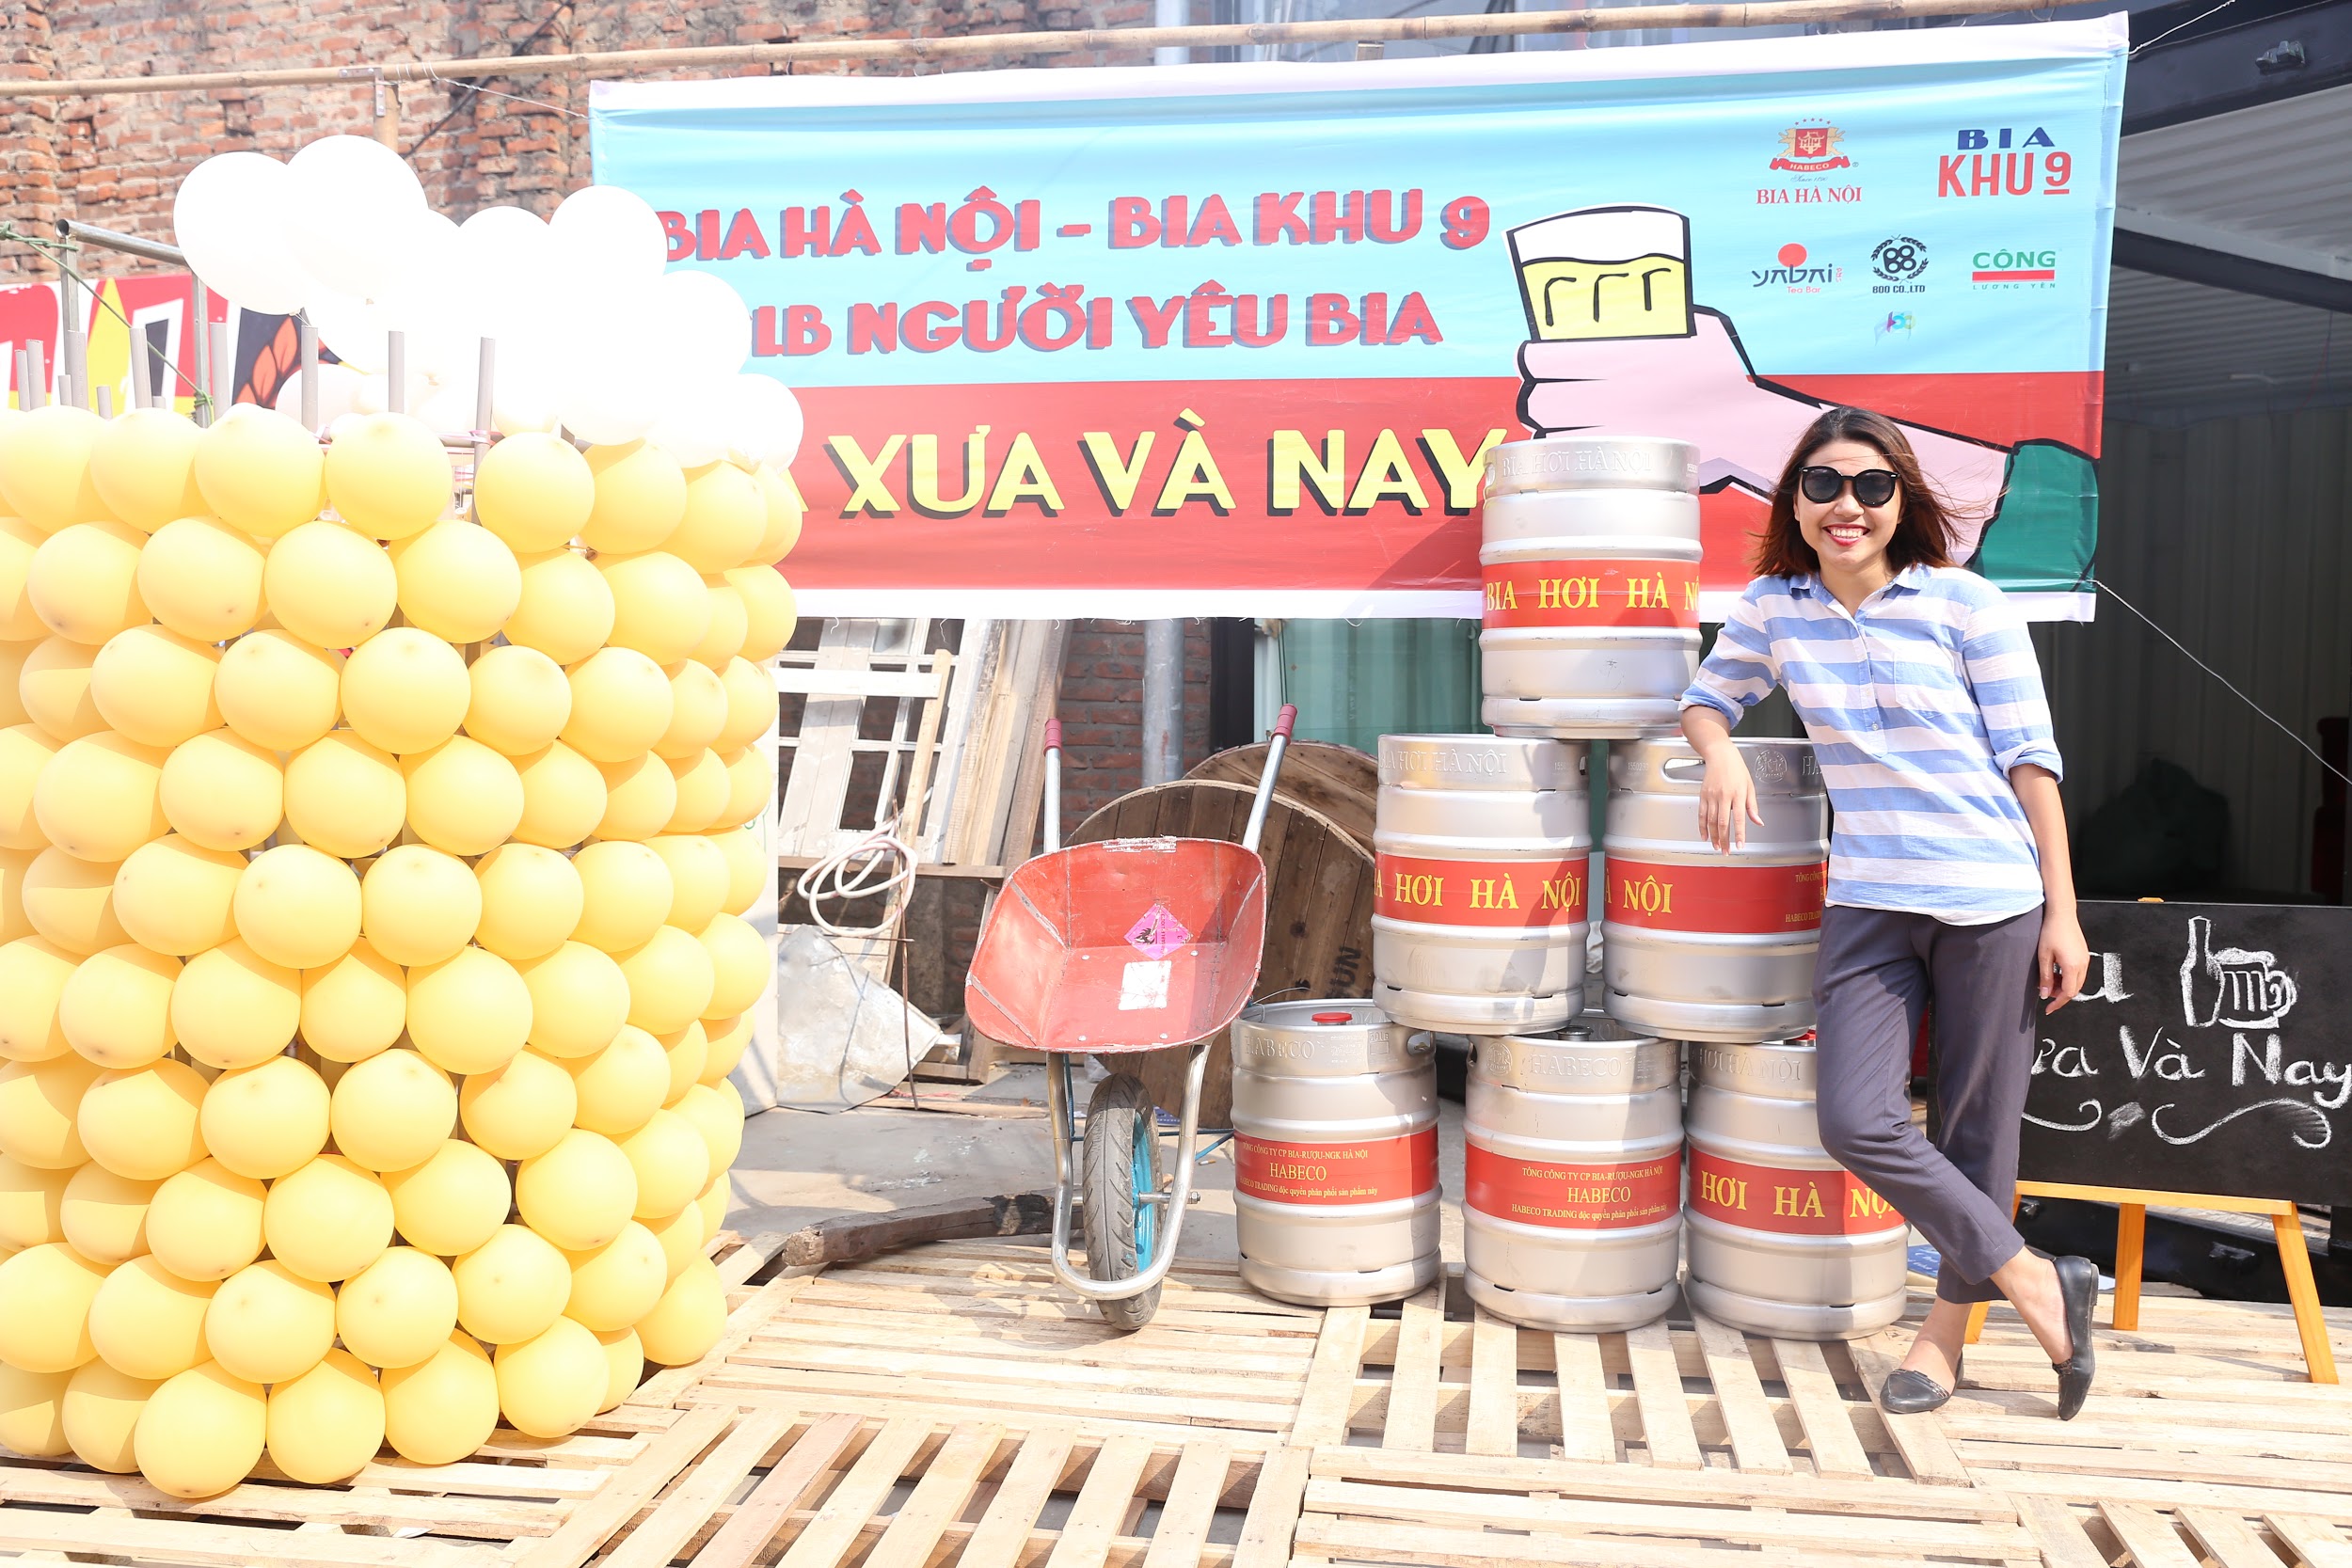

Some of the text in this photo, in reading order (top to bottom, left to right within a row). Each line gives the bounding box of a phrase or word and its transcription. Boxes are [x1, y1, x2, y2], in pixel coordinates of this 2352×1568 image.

[1958, 127, 2055, 150] BIA
[1789, 163, 1830, 171] HABECO
[1790, 174, 1812, 182] Since
[1938, 151, 2072, 198] KHU 9
[1756, 184, 1862, 204] BIA HÀ NỘI
[656, 208, 771, 261] BIA
[780, 188, 882, 259] HÀ
[895, 185, 1041, 271] NỘI
[1108, 194, 1242, 248] BIA
[1253, 188, 1423, 247] KHU
[1439, 196, 1490, 250] 9
[1972, 248, 2057, 271] CỘNG
[1805, 285, 1821, 293] Bar
[1973, 281, 2057, 291] LƯƠNG YÊN
[750, 279, 1444, 356] LB NGƯỜI YÊU BIA
[822, 423, 1065, 520] XƯA
[1077, 407, 1236, 517] VÀ
[1267, 428, 1508, 517] NAY
[1531, 451, 1570, 474] HƠI
[1574, 446, 1609, 472] HÀ
[1486, 579, 1518, 611] BIA
[1537, 576, 1600, 610] HƠI
[1626, 571, 1670, 610] HÀ
[1431, 748, 1463, 772] HÀ
[1466, 749, 1507, 776] NỘI
[1374, 867, 1581, 912] IA HƠI HÀ NỘI
[1623, 874, 1674, 917] NỘI
[1244, 1035, 1316, 1060] HABECO
[1531, 1053, 1622, 1077] HABECO
[2119, 1025, 2206, 1081] Và
[2232, 1032, 2352, 1110] Nay
[1253, 1143, 1268, 1155] CÔNG
[1268, 1148, 1279, 1157] TY
[1278, 1148, 1287, 1158] CP
[1288, 1148, 1342, 1162] BIA-RƯỢU-NGK
[1343, 1148, 1354, 1160] HÀ
[1355, 1148, 1369, 1160] NỘI
[1269, 1162, 1327, 1181] HABECO
[1522, 1164, 1663, 1183] TỔNG CÔNG TY CP BIA-RƯỢU-NGK HÀ NỘI
[1254, 1180, 1279, 1193] TRADING
[1279, 1185, 1289, 1195] độc
[1289, 1185, 1307, 1197] quyền
[1323, 1186, 1337, 1198] phối
[1349, 1184, 1367, 1197] phẩm
[1566, 1185, 1631, 1204] HABECO
[1700, 1169, 1748, 1211] HƠI
[1772, 1180, 1825, 1218] HÀ
[1511, 1203, 1541, 1216] HABECO
[1542, 1207, 1578, 1219] TRADING
[1578, 1209, 1591, 1220] độc
[1591, 1208, 1611, 1222] quyền
[1611, 1209, 1626, 1221] phân
[1626, 1206, 1639, 1220] phối
